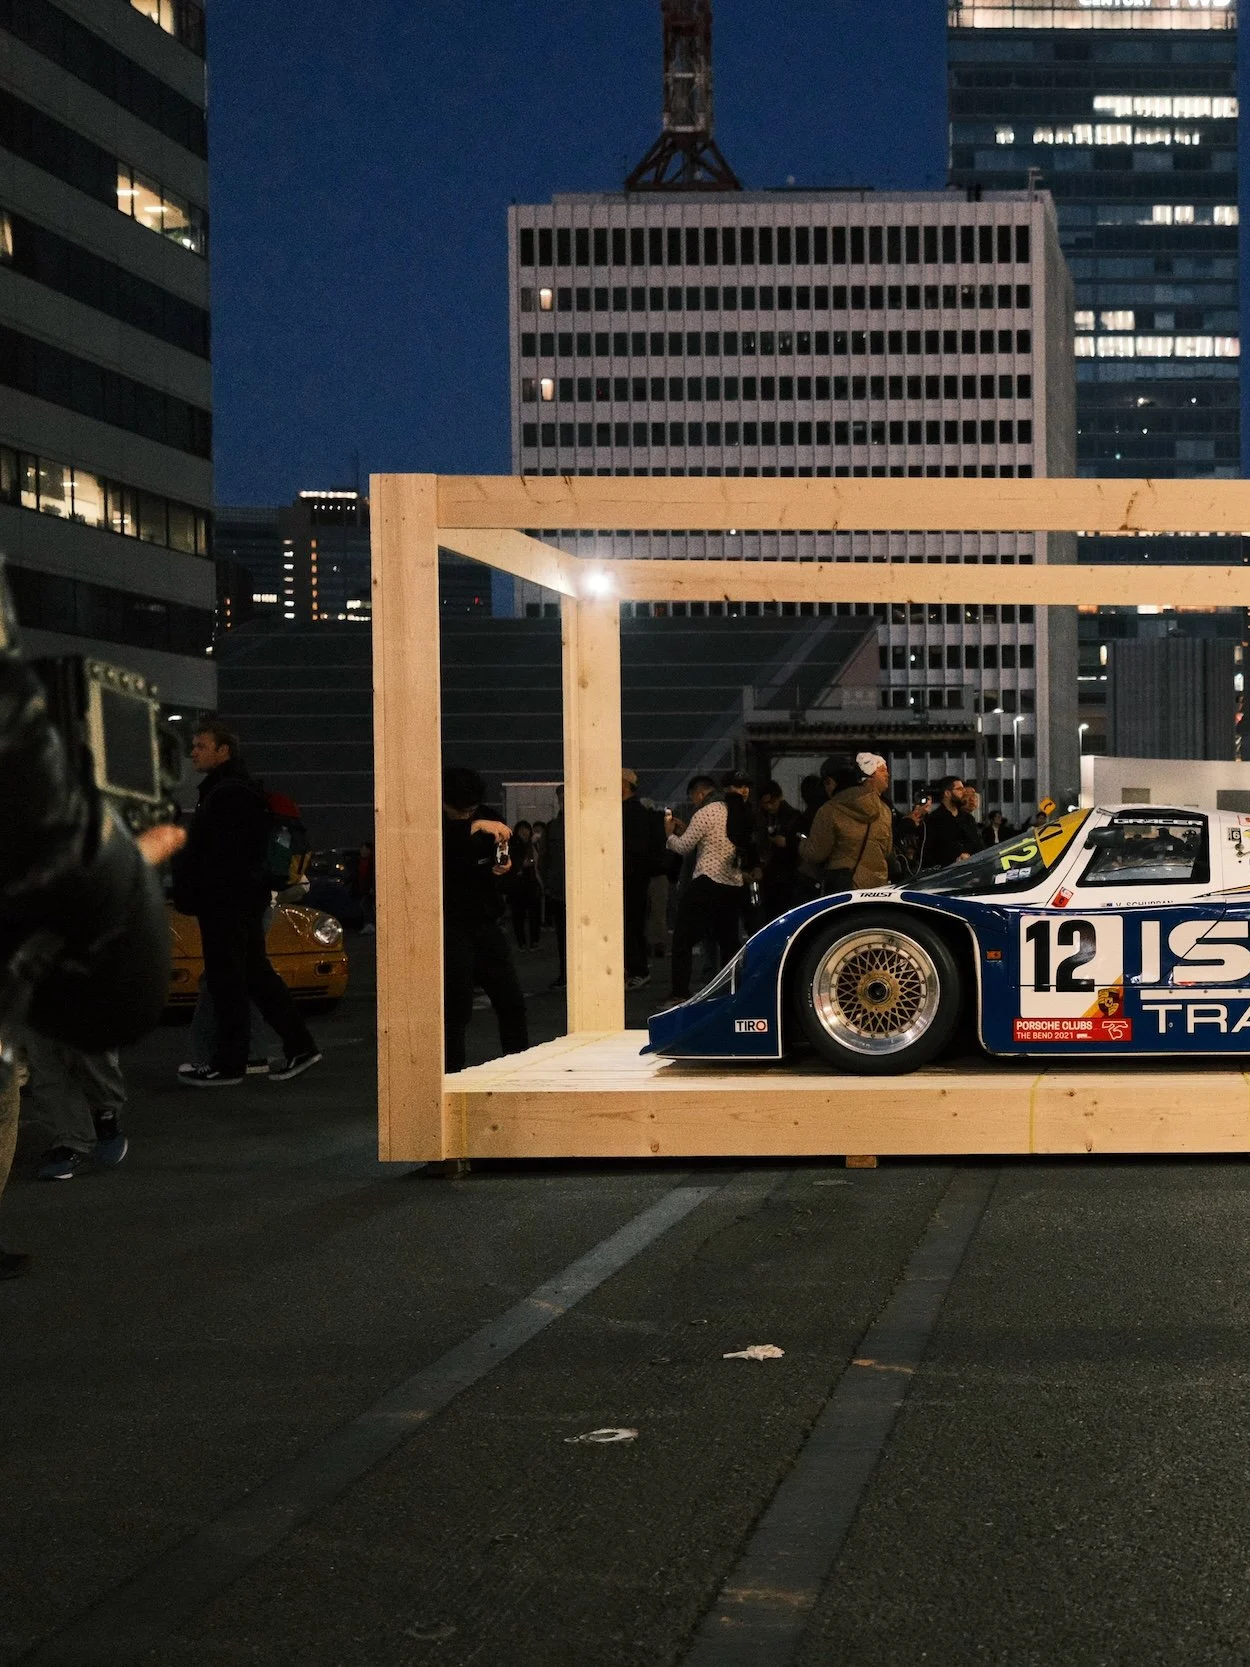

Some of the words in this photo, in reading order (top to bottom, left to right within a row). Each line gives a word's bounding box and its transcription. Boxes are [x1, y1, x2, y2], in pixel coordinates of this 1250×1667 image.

[1026, 919, 1096, 992] 12
[736, 1020, 767, 1031] TIRO
[1016, 1021, 1060, 1030] PORSCHE
[1062, 1021, 1093, 1030] CLUBS
